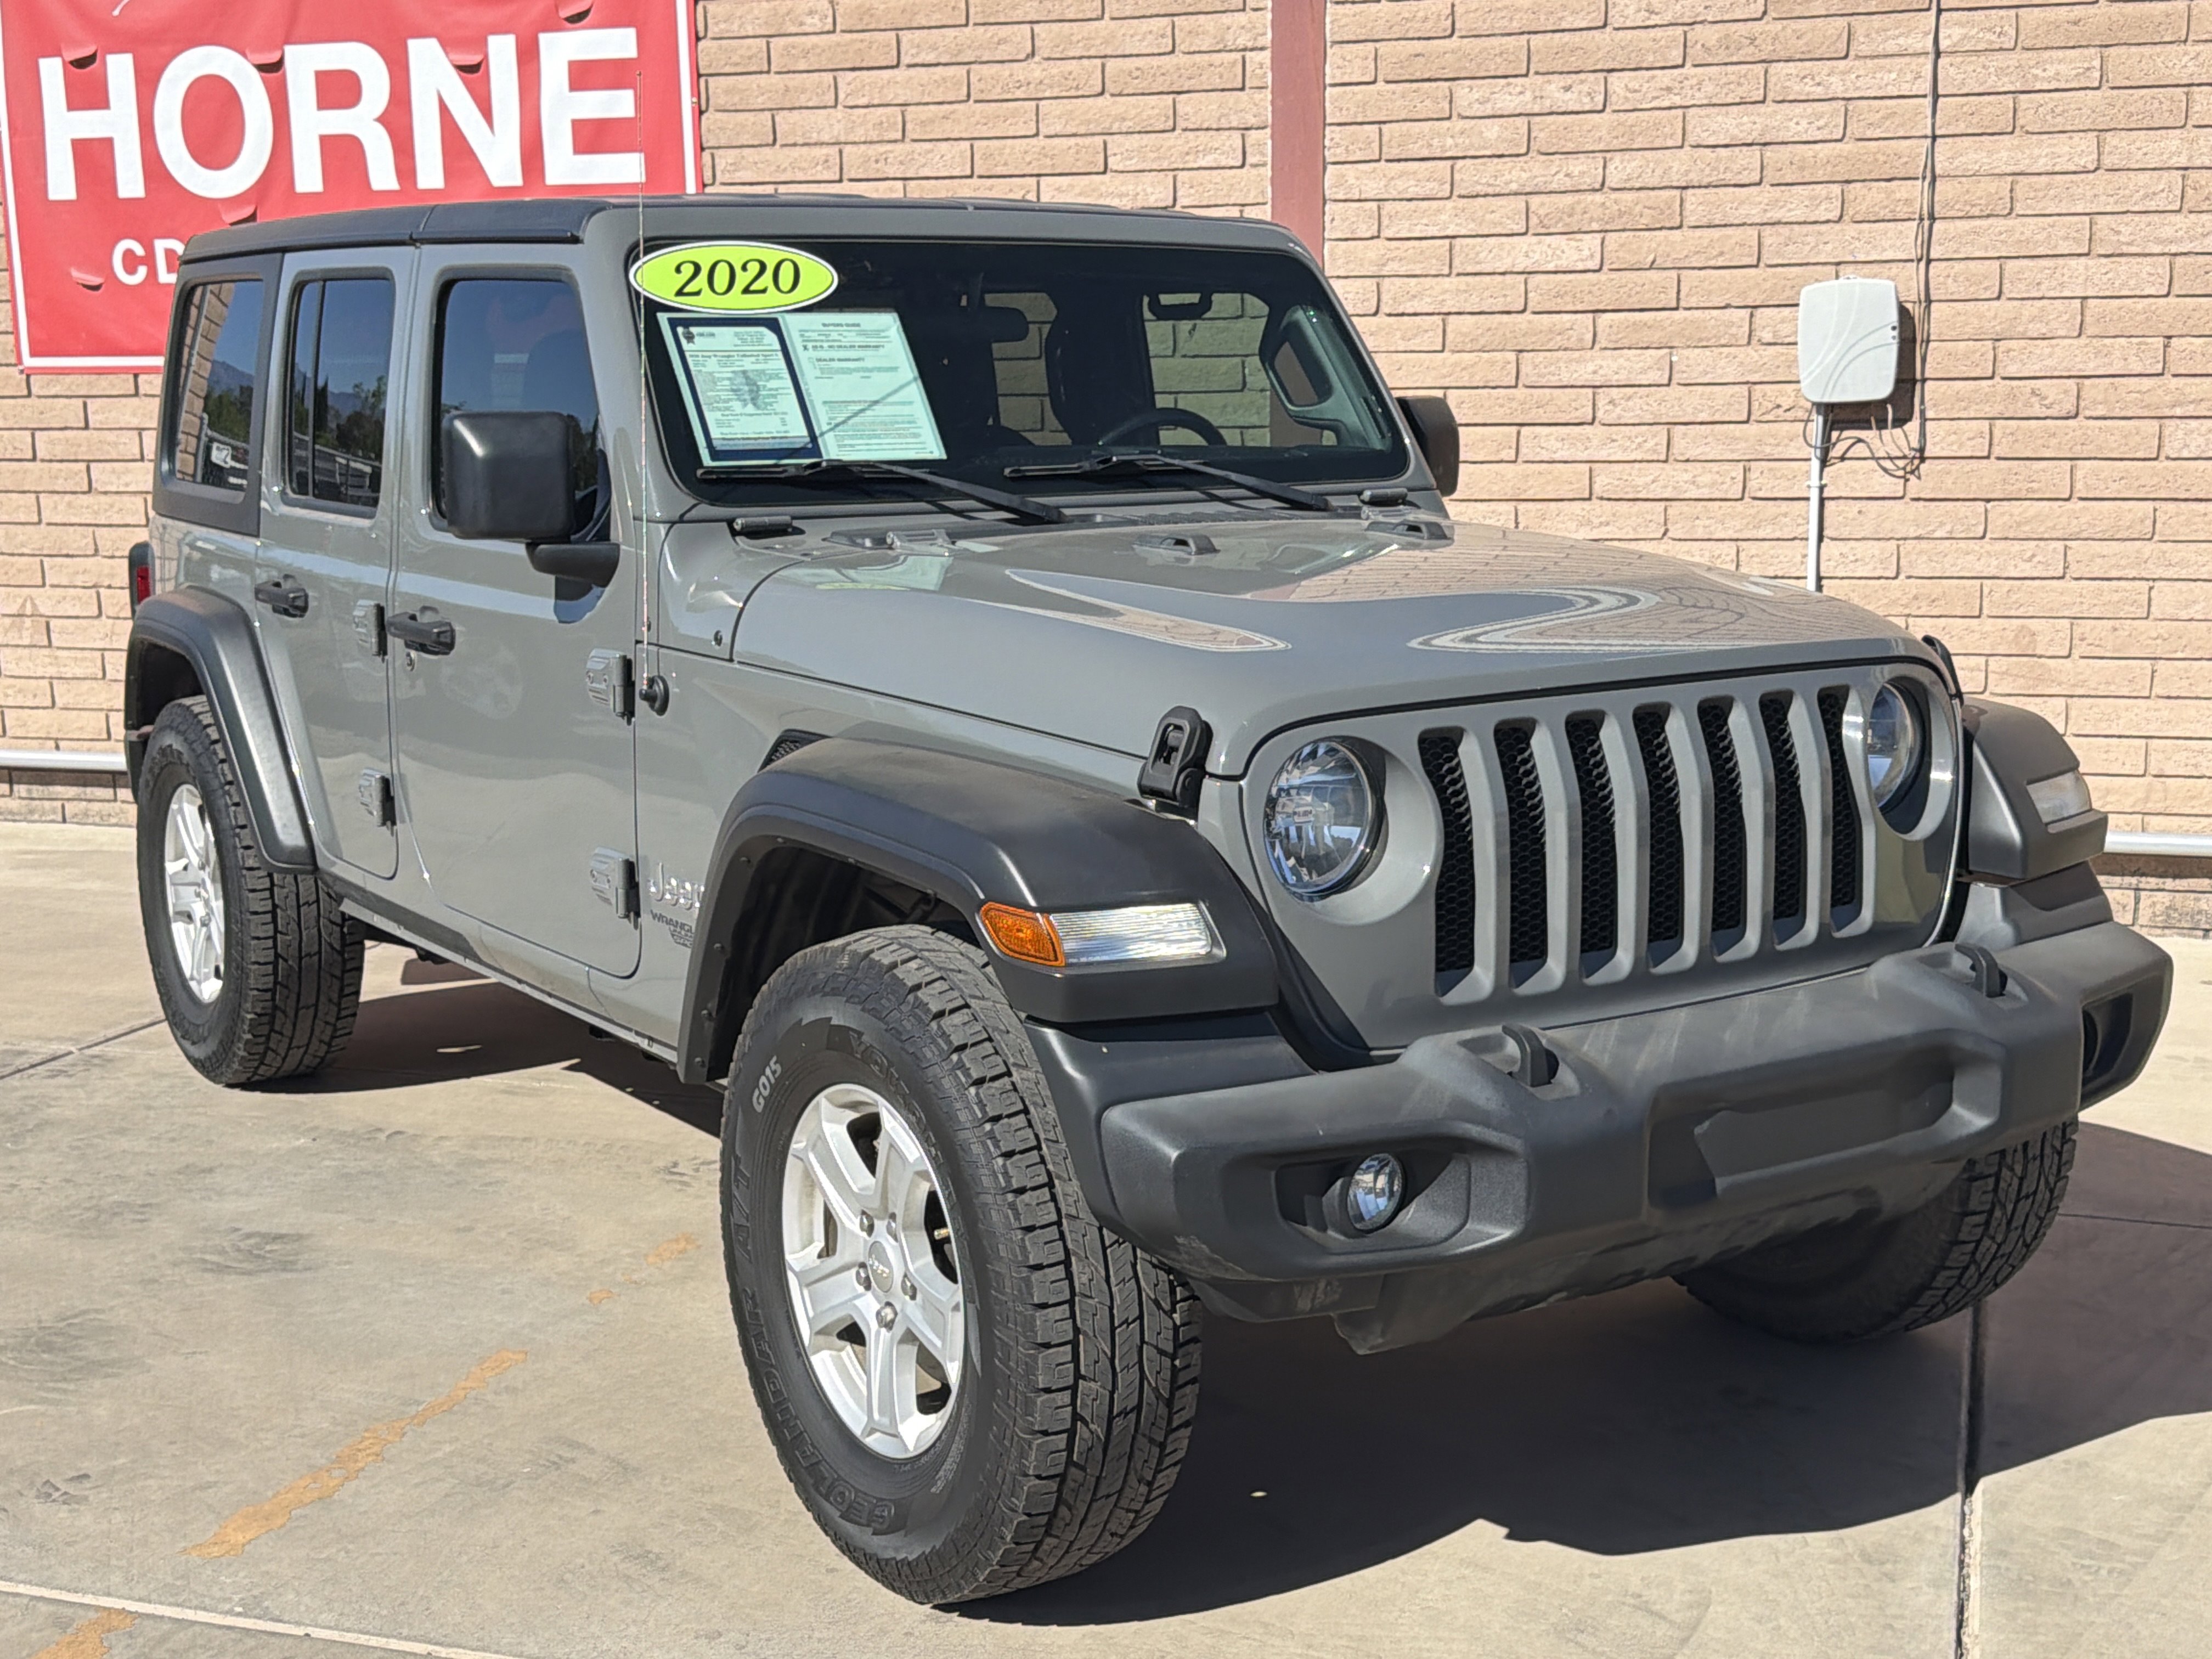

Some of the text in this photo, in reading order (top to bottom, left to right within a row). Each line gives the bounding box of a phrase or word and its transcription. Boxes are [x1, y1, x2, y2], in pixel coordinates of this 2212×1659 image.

[38, 27, 645, 201] HORNE
[674, 258, 802, 297] 2020
[650, 909, 695, 934] WRANGL
[752, 1055, 782, 1113] G015
